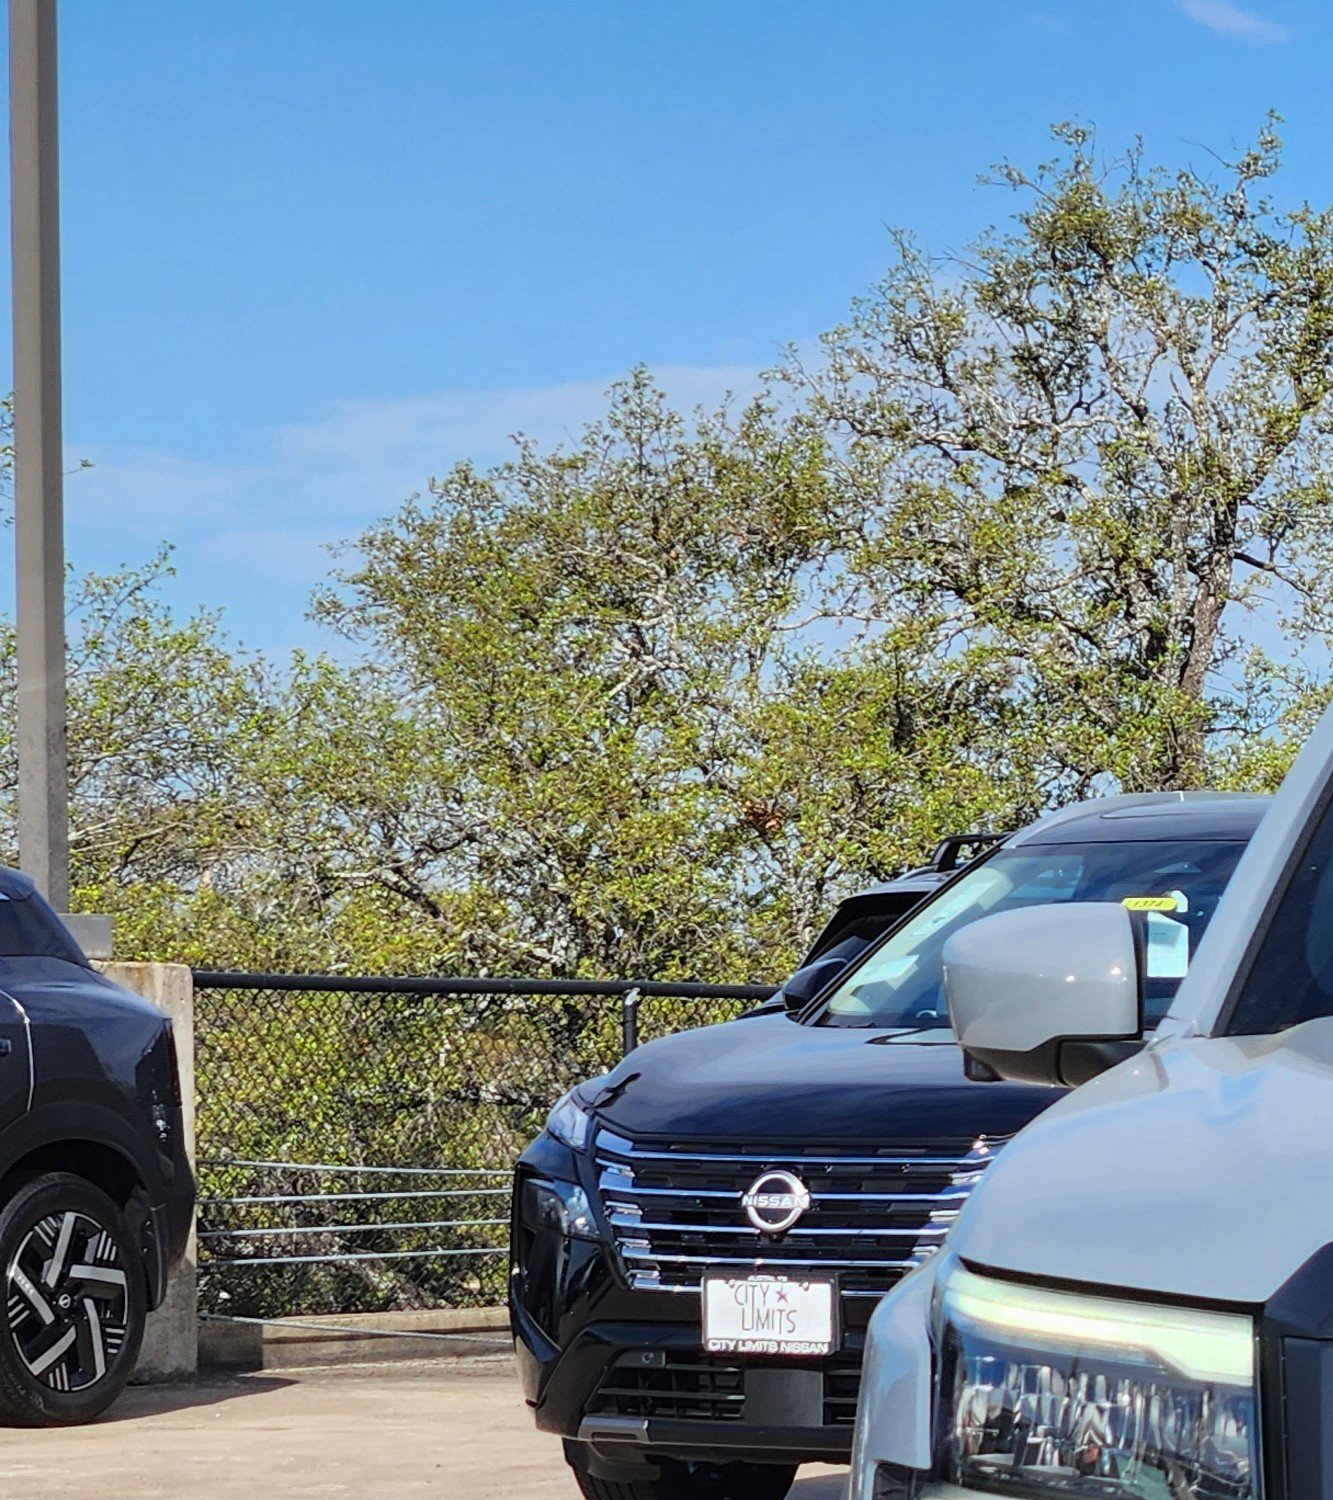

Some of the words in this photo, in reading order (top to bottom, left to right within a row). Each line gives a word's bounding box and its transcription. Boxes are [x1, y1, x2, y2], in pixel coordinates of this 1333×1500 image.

[742, 1194, 810, 1209] NISSAN
[734, 1283, 770, 1308] CITY
[741, 1308, 797, 1335] LIMITS
[708, 1339, 736, 1351] CITY
[738, 1340, 778, 1353] LIMITS
[779, 1341, 829, 1355] NISSAN
